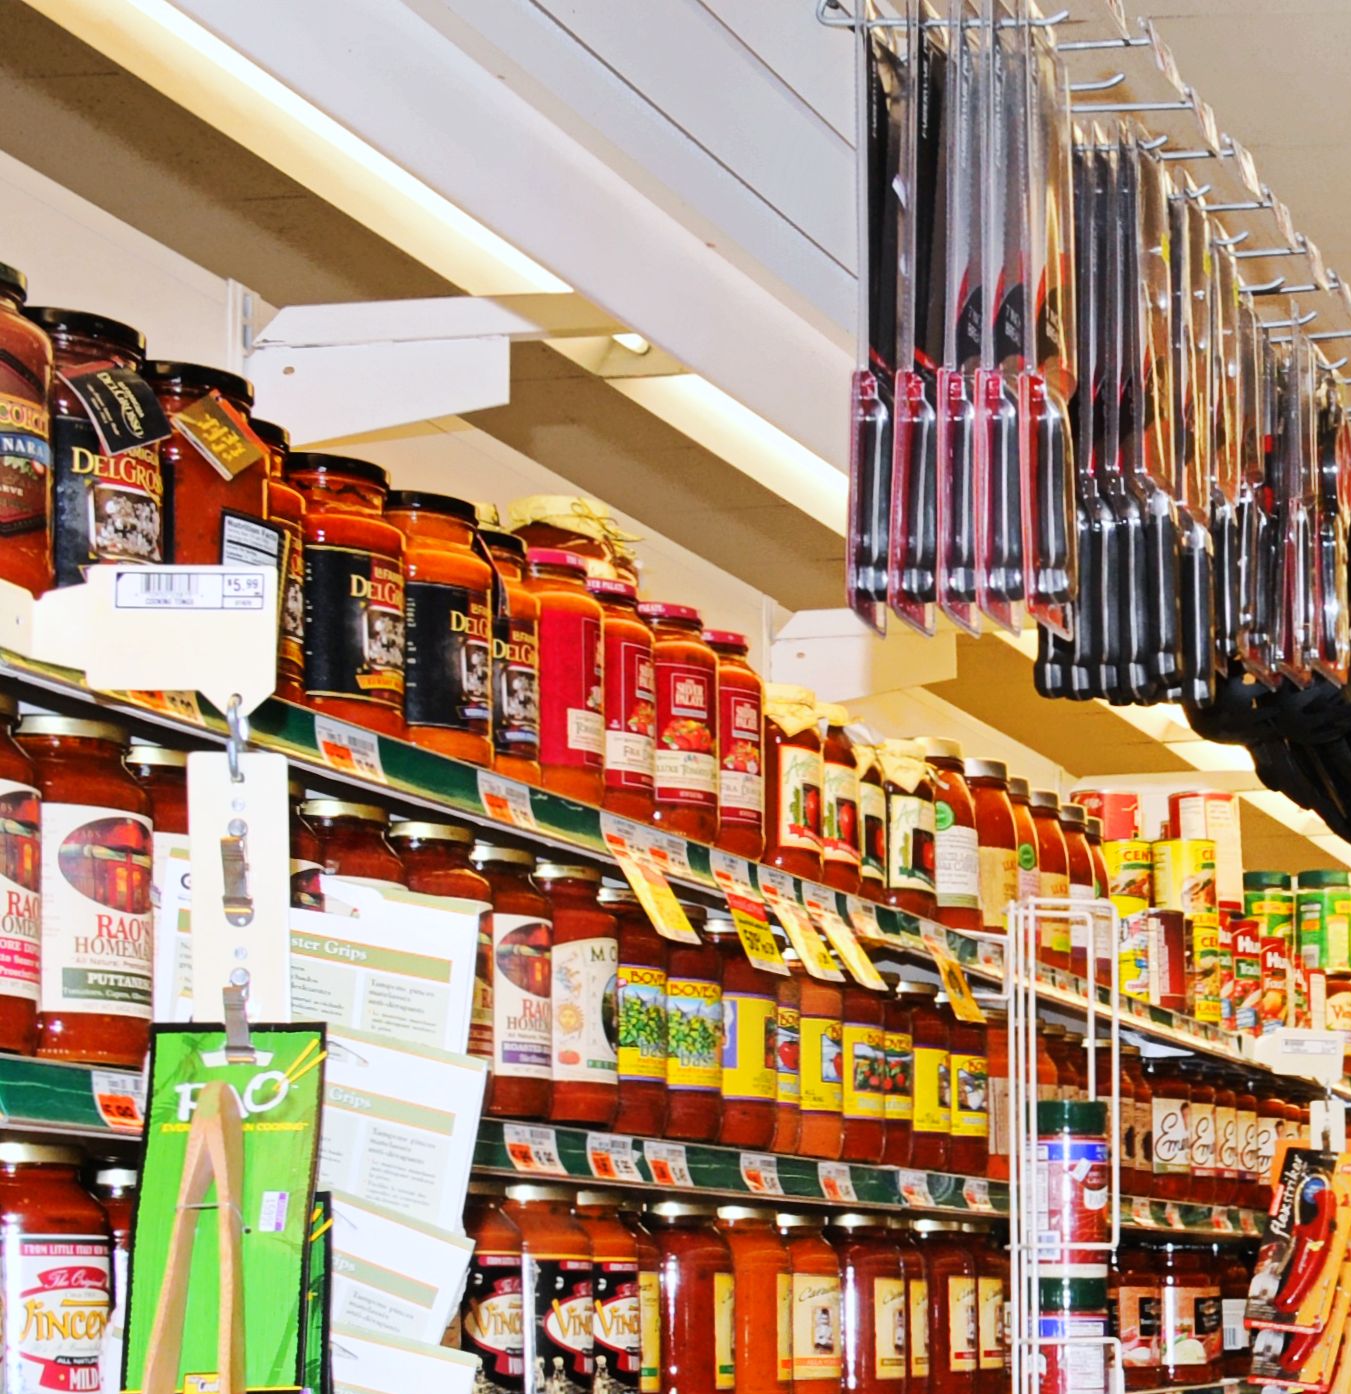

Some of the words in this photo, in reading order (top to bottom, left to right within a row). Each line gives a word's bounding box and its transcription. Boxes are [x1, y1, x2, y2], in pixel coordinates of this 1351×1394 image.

[325, 941, 368, 961] Grips
[329, 1087, 371, 1111] Grips
[69, 1367, 99, 1390] MILD
